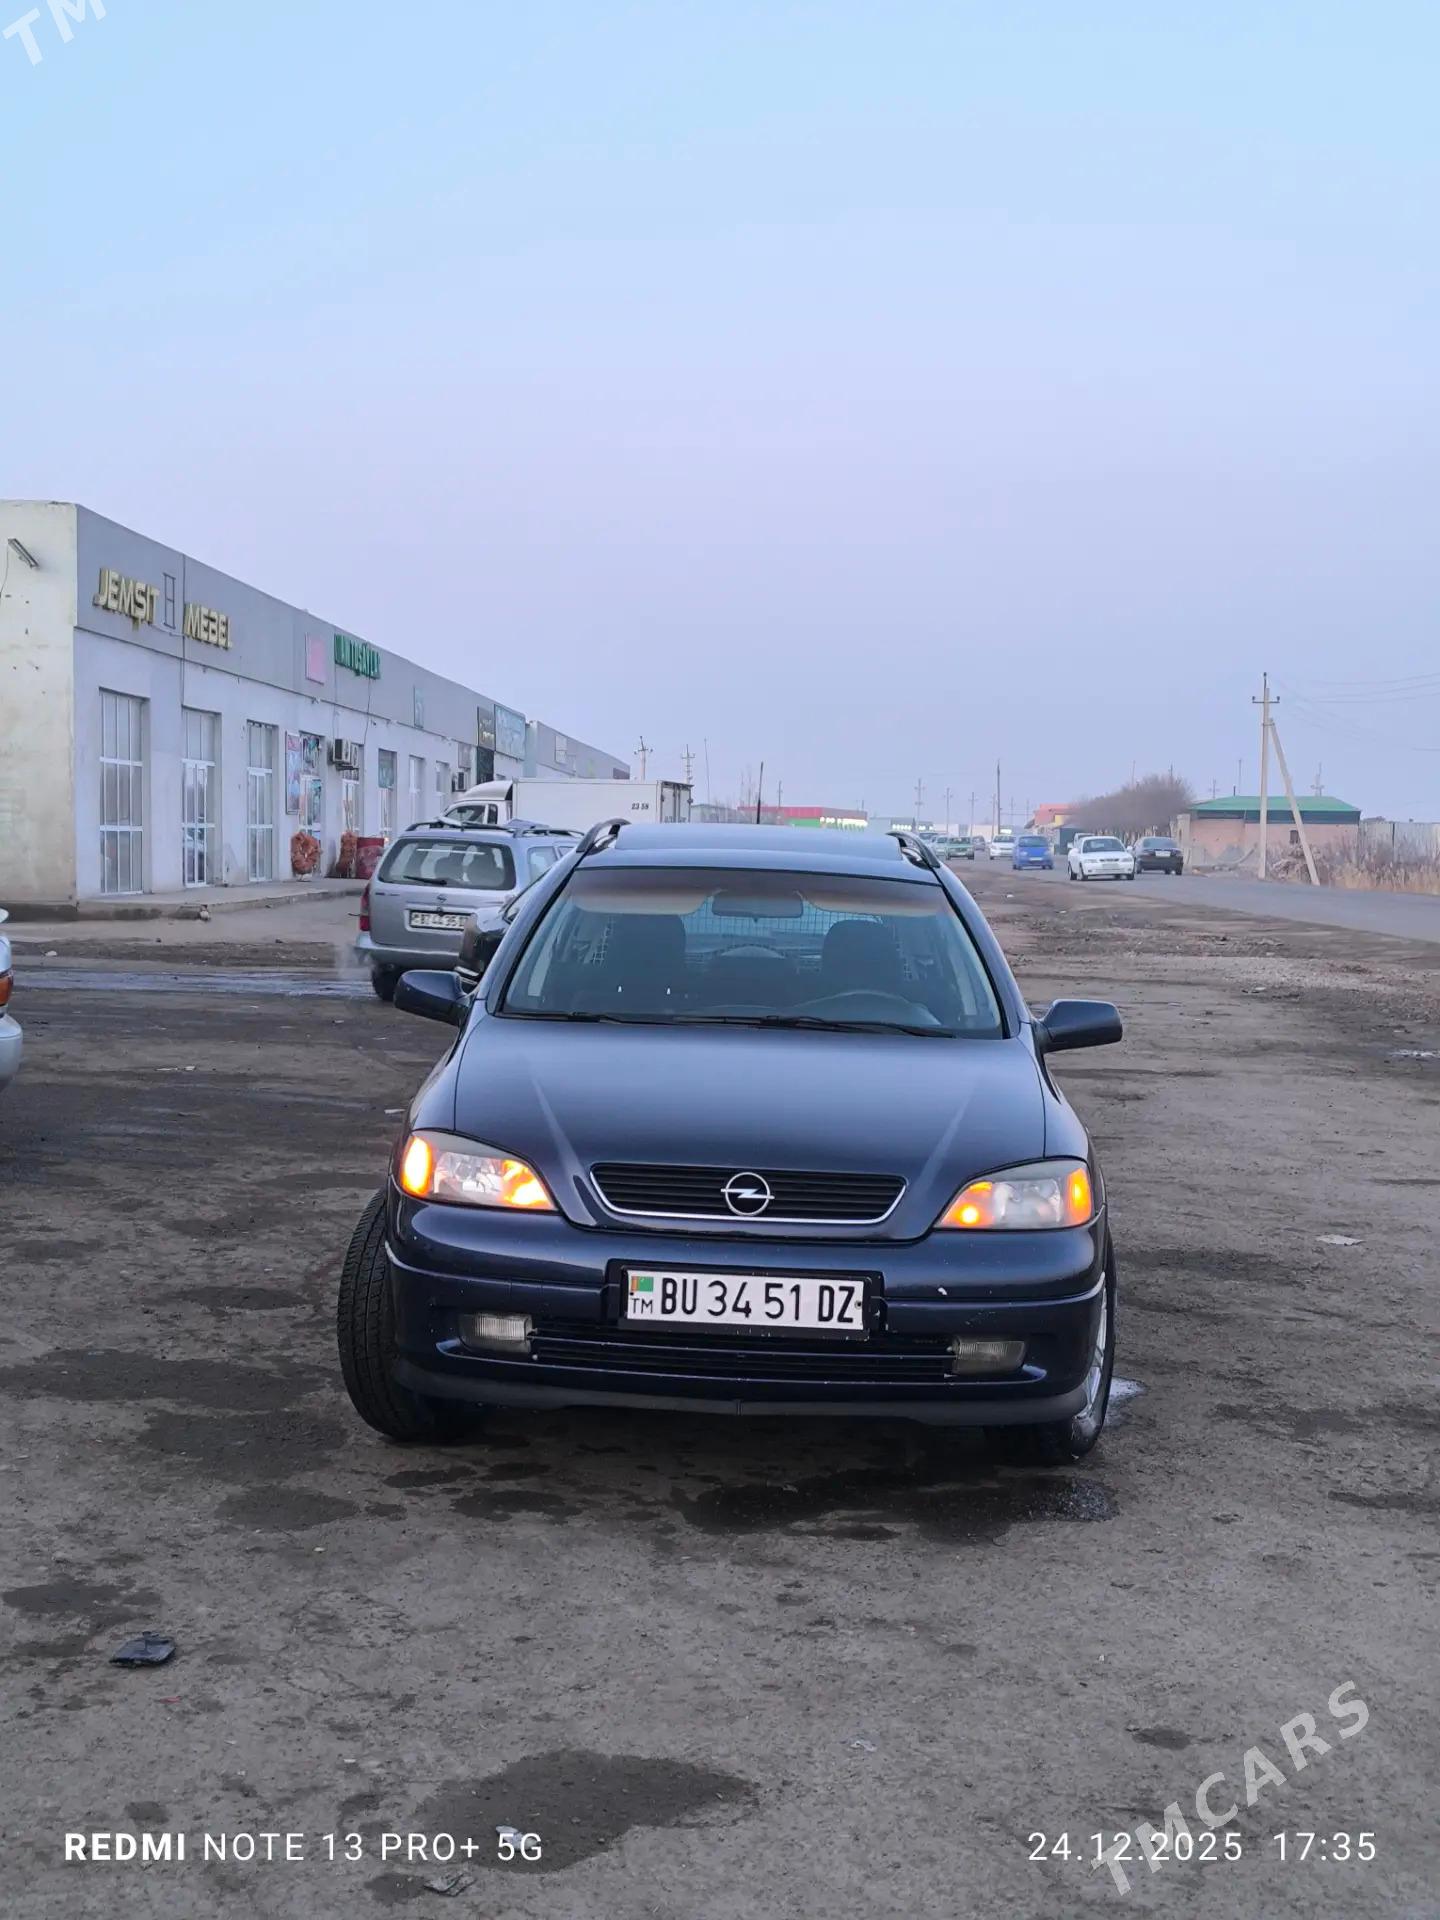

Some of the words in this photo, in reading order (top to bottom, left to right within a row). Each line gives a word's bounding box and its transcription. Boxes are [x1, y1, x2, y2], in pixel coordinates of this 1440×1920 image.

[93, 567, 160, 632] JEMŞIT
[183, 603, 233, 650] MEBEL
[631, 1297, 653, 1315] TM
[661, 1277, 698, 1315] BU
[707, 1279, 752, 1319] 34
[764, 1282, 801, 1322] 51
[817, 1284, 855, 1324] DZ
